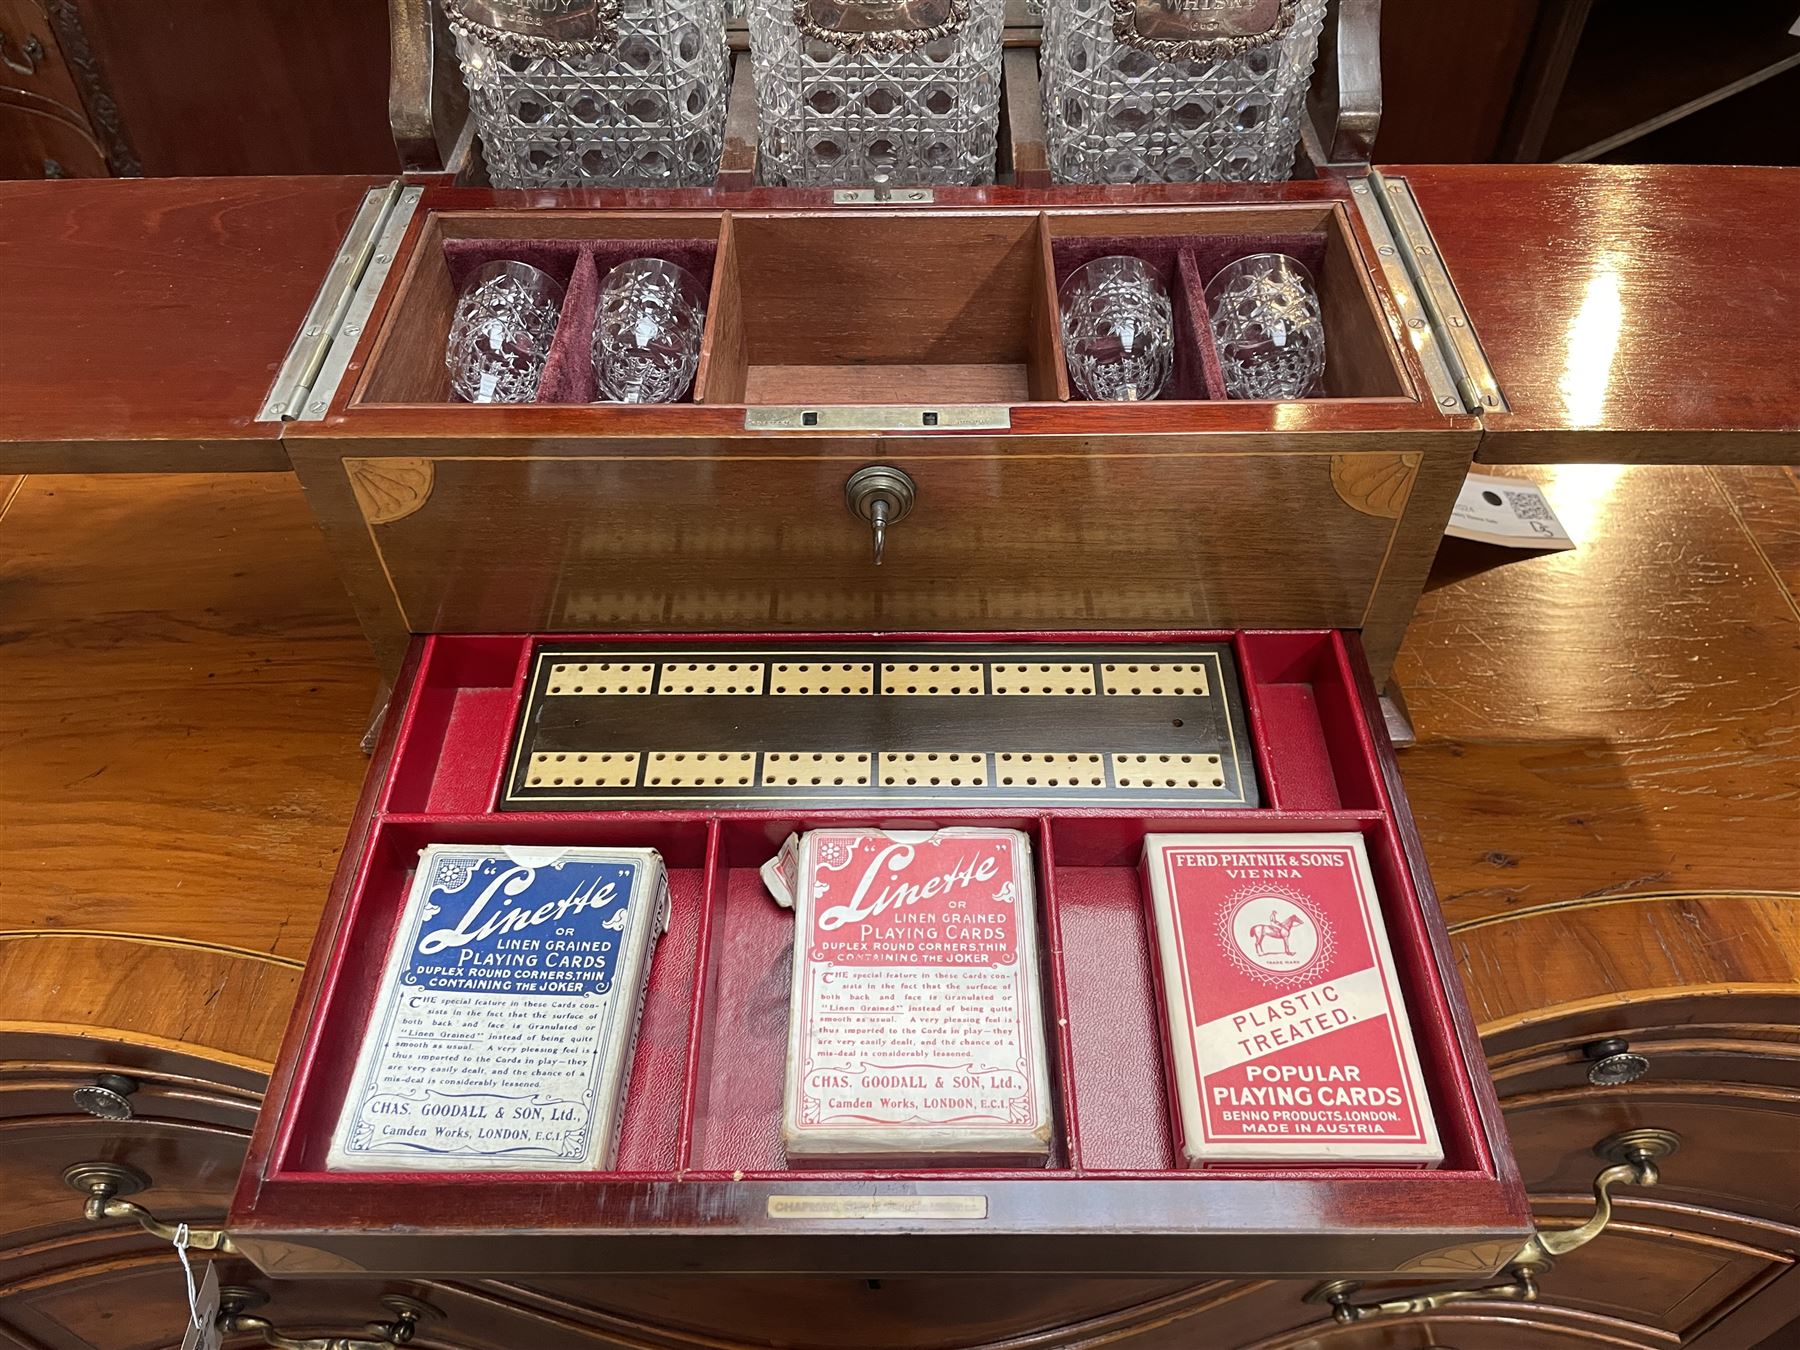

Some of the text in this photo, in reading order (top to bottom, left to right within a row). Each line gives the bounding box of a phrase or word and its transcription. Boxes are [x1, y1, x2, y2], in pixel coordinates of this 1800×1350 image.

[1226, 869, 1302, 878] VIENNA
[894, 913, 1006, 923] LINEN GRAINED
[555, 927, 574, 936] OR
[861, 924, 1005, 941] PLAYING CARDS
[496, 939, 611, 951] LINEN GRAINED
[822, 941, 867, 950] DUPLEX
[873, 942, 914, 951] ROUND
[457, 948, 605, 968] PLAYING CARDS
[922, 954, 942, 962] THE
[946, 953, 989, 963] JOKER
[416, 965, 464, 976] DUPLEX
[468, 968, 511, 978] ROUND
[821, 971, 848, 984] THE
[853, 971, 882, 980] special
[428, 977, 583, 991] CONTAINING THE JOKER
[409, 996, 437, 1008] THE
[908, 1004, 941, 1012] instead
[960, 1005, 983, 1013] being
[1233, 985, 1340, 1032] PLASTIC
[1238, 1007, 1357, 1056] TREATED.
[540, 1034, 564, 1043] being
[392, 1051, 412, 1059] thus
[520, 1046, 558, 1054] pleasing
[430, 1065, 458, 1074] easily
[491, 1067, 509, 1075] and
[531, 1068, 561, 1076] chance
[1246, 1065, 1361, 1082] POPULAR
[439, 1078, 497, 1087] considerably
[812, 1075, 1021, 1090] CHAS. GOODALL & SON, Ltd.,
[1214, 1086, 1402, 1106] PLAYING CARDS
[828, 1097, 872, 1108] Camden
[879, 1098, 918, 1109] Works,
[924, 1098, 976, 1109] LONDON,
[371, 1101, 580, 1122] CHAS. GOODALL & SON, Ltd.,
[1222, 1110, 1270, 1121] BENNO
[382, 1125, 426, 1136] Camden
[435, 1126, 472, 1139] Works,
[478, 1128, 530, 1141] LONDON,
[1242, 1123, 1385, 1133] MADE IN AUSTRIA
